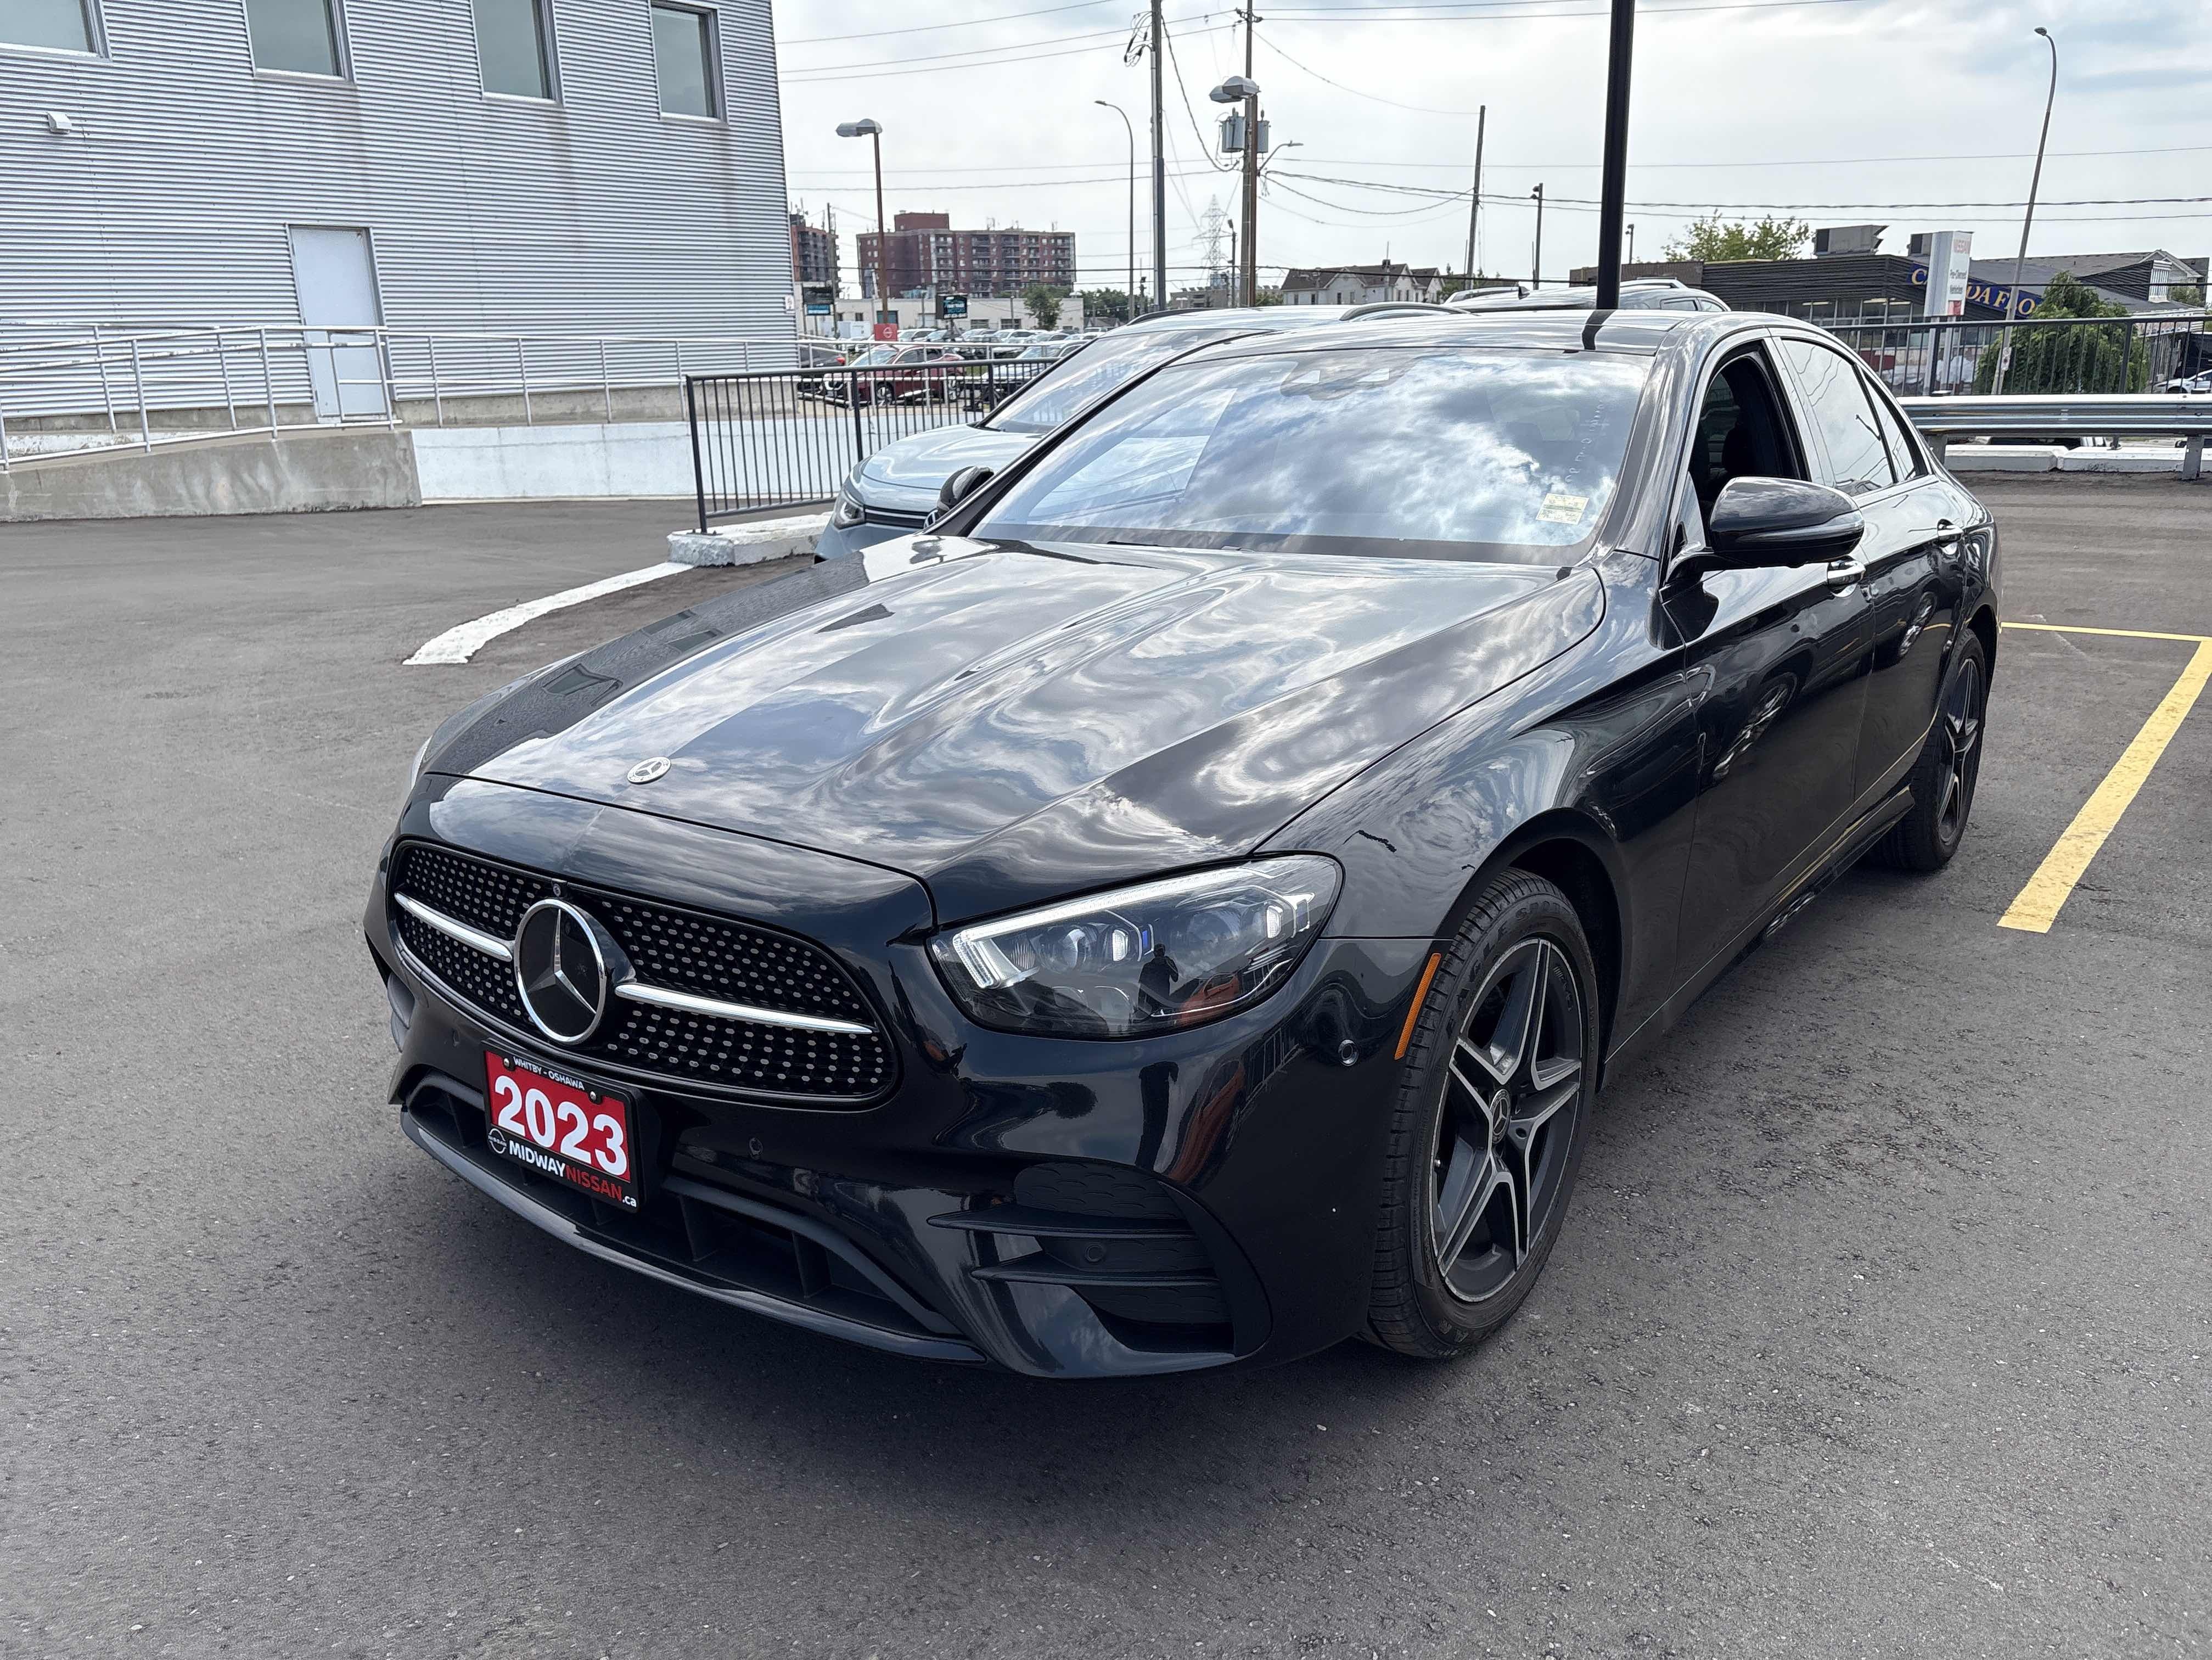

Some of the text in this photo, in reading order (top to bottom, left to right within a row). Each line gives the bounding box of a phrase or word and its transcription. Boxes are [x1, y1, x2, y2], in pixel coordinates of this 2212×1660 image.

[513, 1056, 542, 1074] WHITBY
[549, 1071, 585, 1090] OSHAWA
[495, 1075, 627, 1176] 2023
